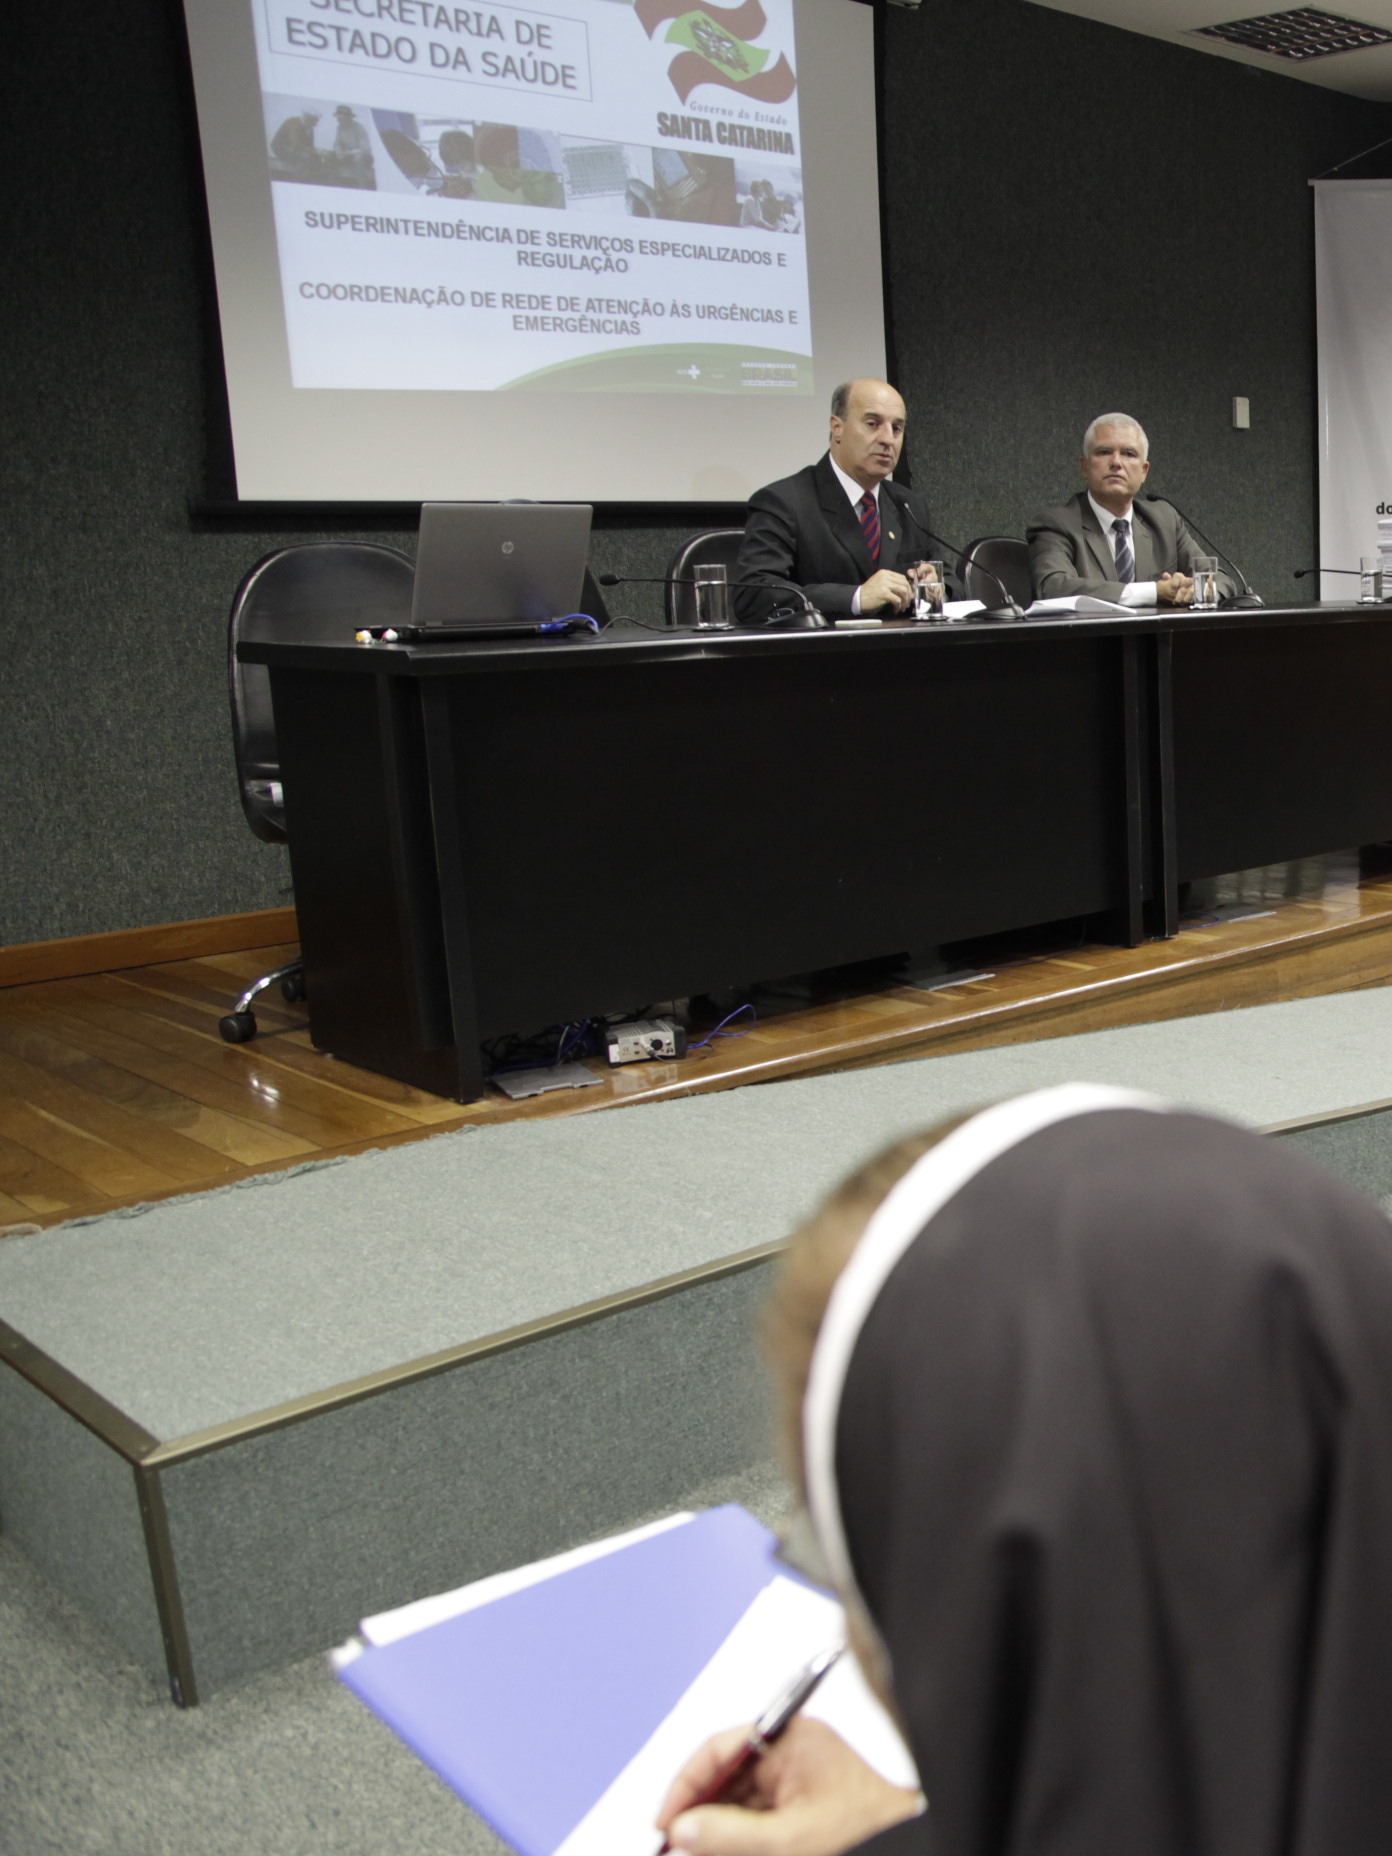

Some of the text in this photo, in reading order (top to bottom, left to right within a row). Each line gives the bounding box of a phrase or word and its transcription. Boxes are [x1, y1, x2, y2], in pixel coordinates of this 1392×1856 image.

[514, 19, 553, 49] DE
[285, 16, 578, 90] ESTADO DA SAÚDE
[689, 100, 787, 126] Governo do Estado
[656, 111, 795, 155] SANTA CATARINA
[304, 210, 787, 267] SUPERINTENDÊNCIA DE SERVIÇOS ESPECIALIZADOS E
[517, 250, 628, 275] REGULAÇÃO
[299, 282, 798, 325] COORDENAÇÃO DE REDE DE ATENÇÃO ÀS URGÊNCIAS E
[512, 314, 641, 336] EMERGÊNCIAS
